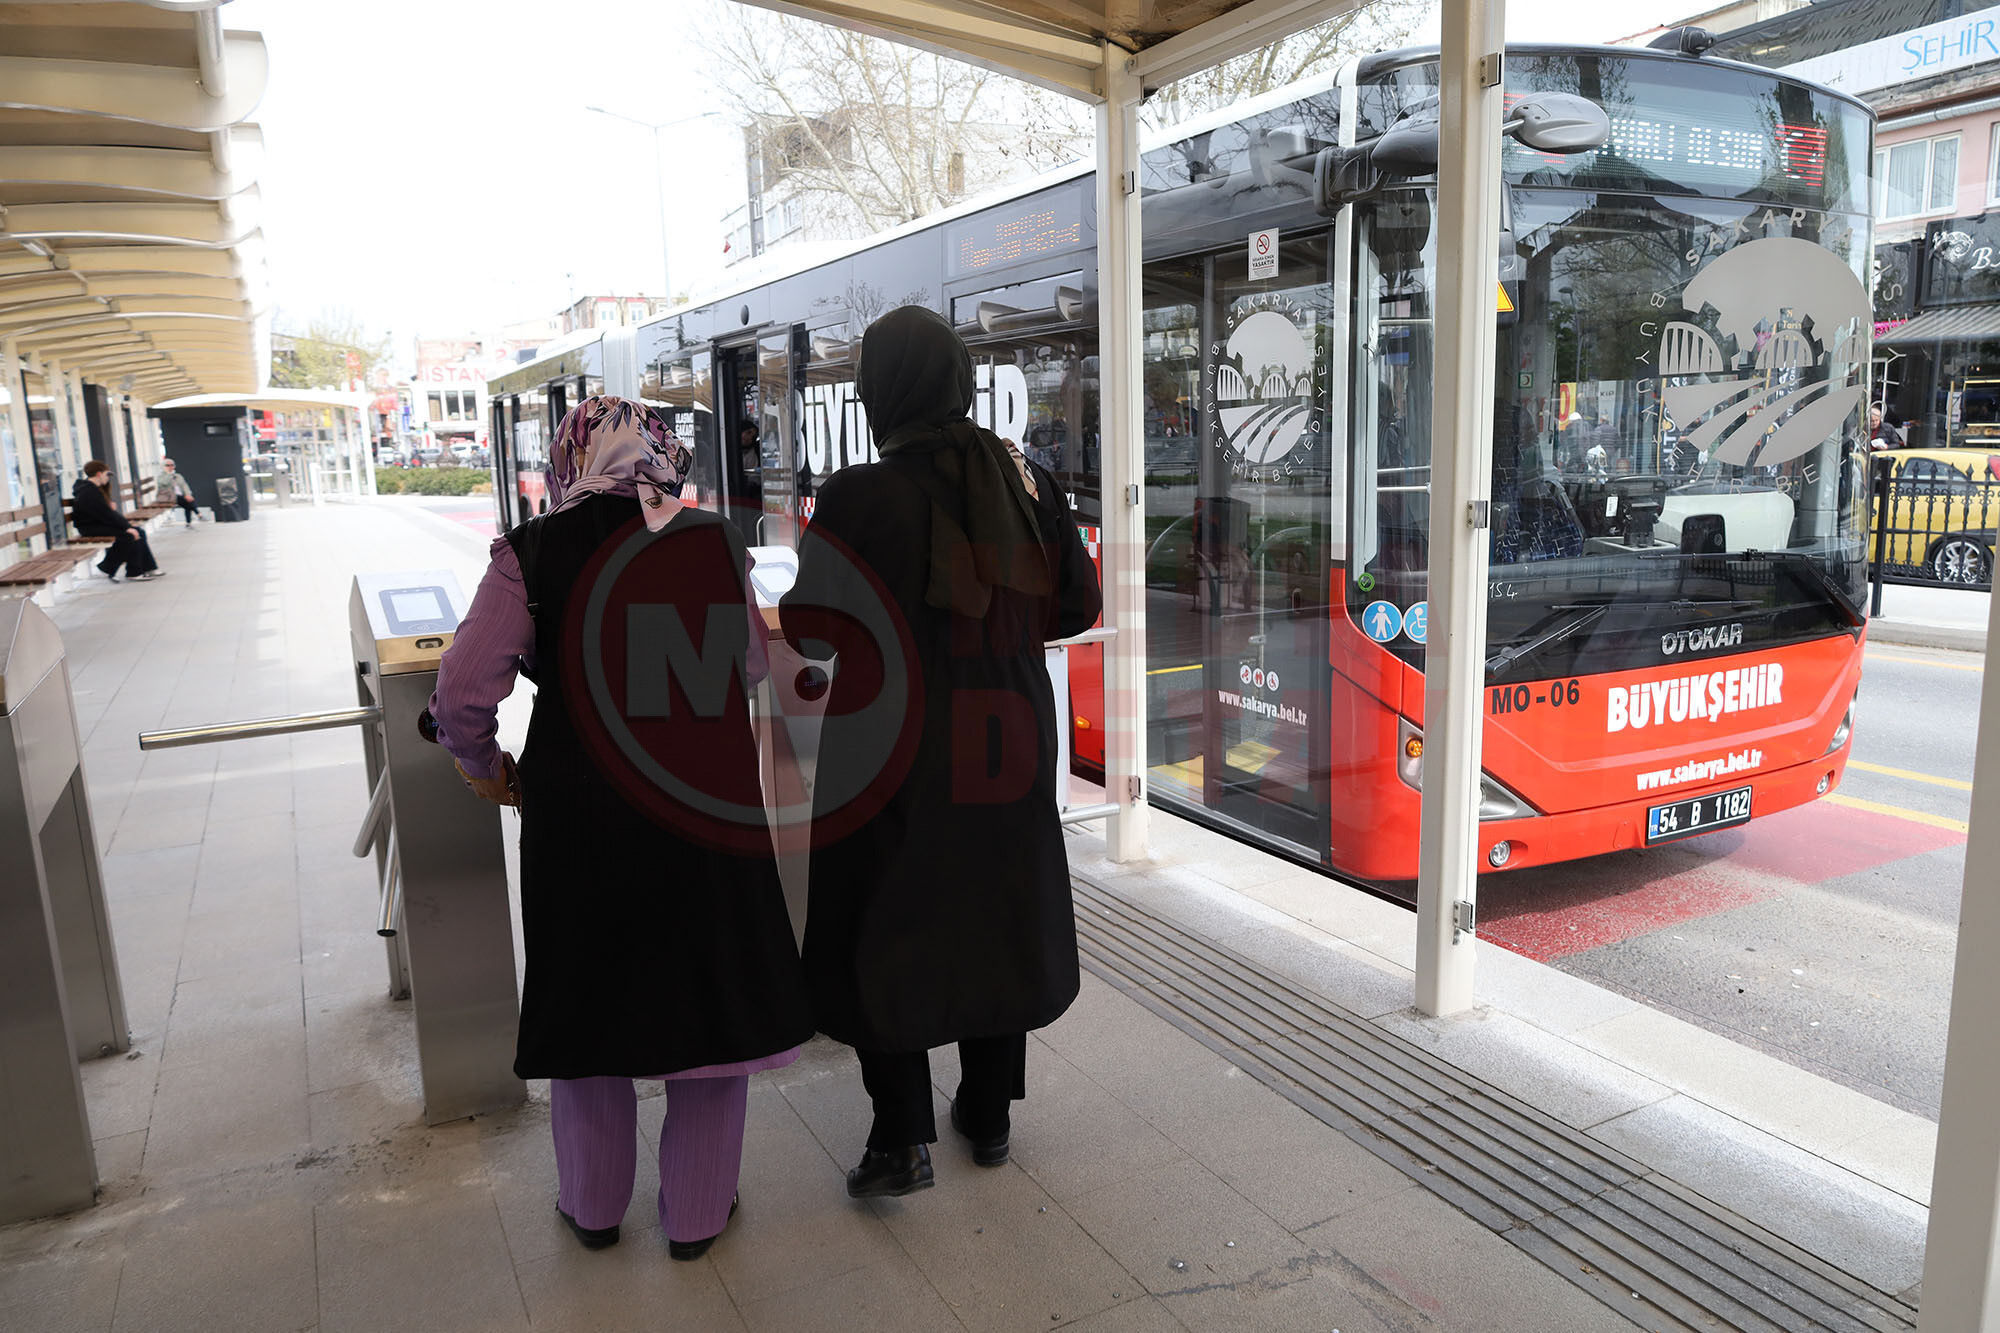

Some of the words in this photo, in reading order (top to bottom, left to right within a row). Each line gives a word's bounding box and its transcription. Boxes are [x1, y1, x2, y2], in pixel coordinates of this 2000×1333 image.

[1685, 207, 1854, 267] SAKARYA
[1226, 292, 1302, 329] SAKARYA
[1205, 343, 1261, 484] BÜYÜKŞEHİR
[1661, 622, 1744, 656] OTOKAR
[1218, 689, 1307, 726] www.sakarya.bel.tr
[1607, 662, 1784, 733] BÜYÜKŞEHİR
[1636, 748, 1762, 791] www.sakarya.bel.tr
[1659, 806, 1678, 833] 54
[1690, 801, 1702, 826] B
[1715, 790, 1749, 820] 1182
